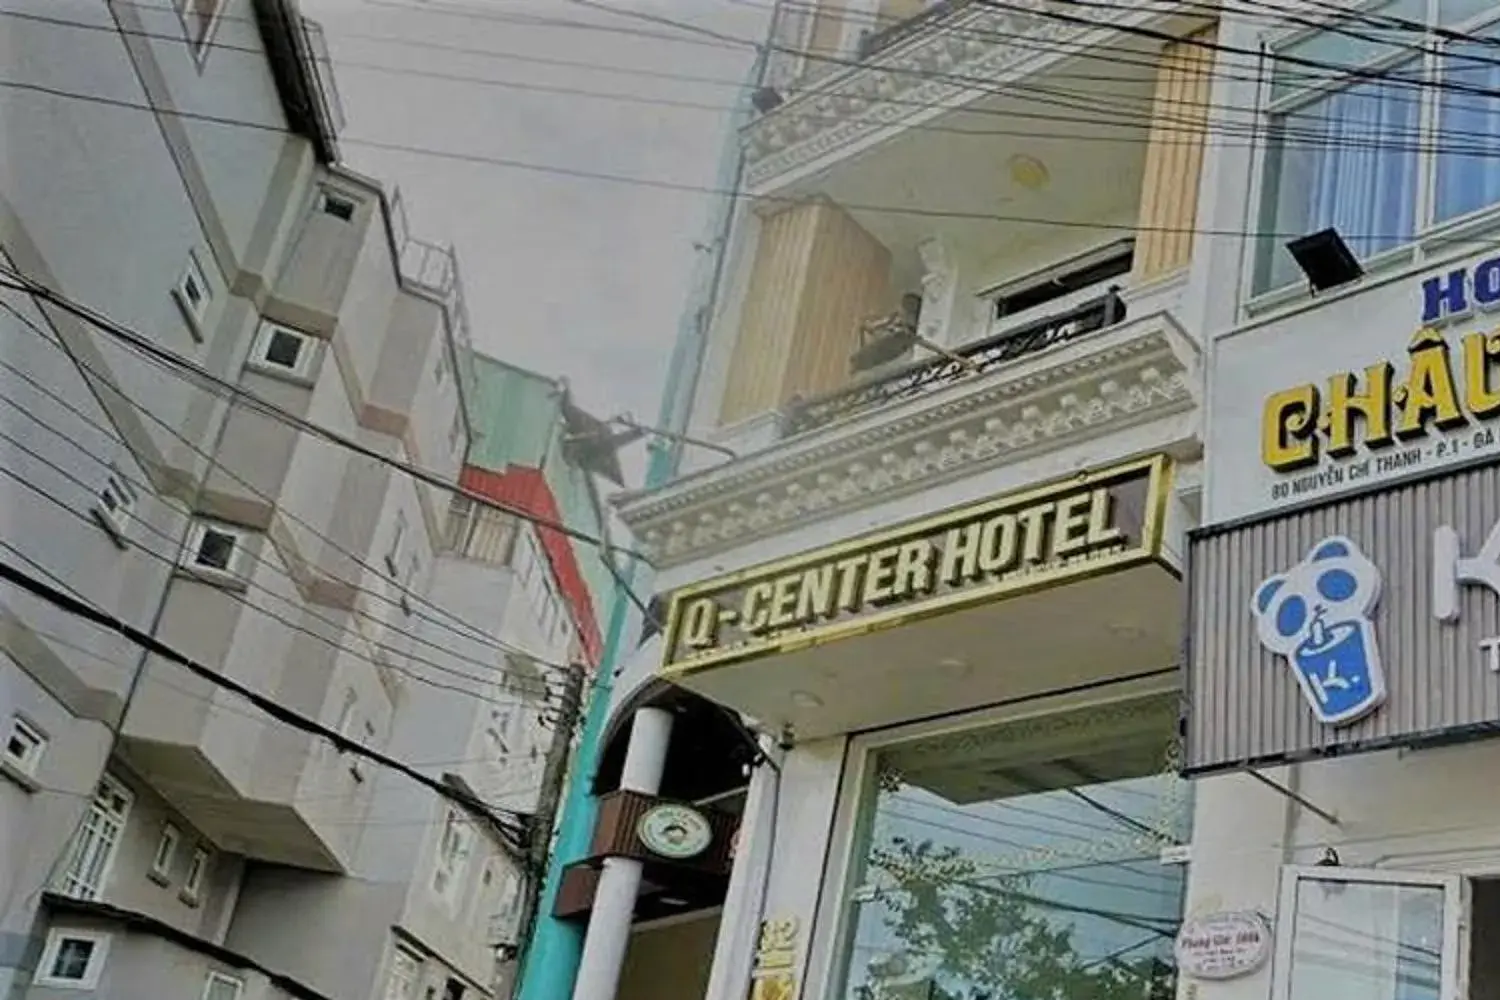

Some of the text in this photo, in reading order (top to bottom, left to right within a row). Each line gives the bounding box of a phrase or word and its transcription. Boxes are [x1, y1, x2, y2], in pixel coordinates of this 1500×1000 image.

[1376, 447, 1422, 474] THANH
[683, 488, 1121, 650] Q-CENTER HOTEL
